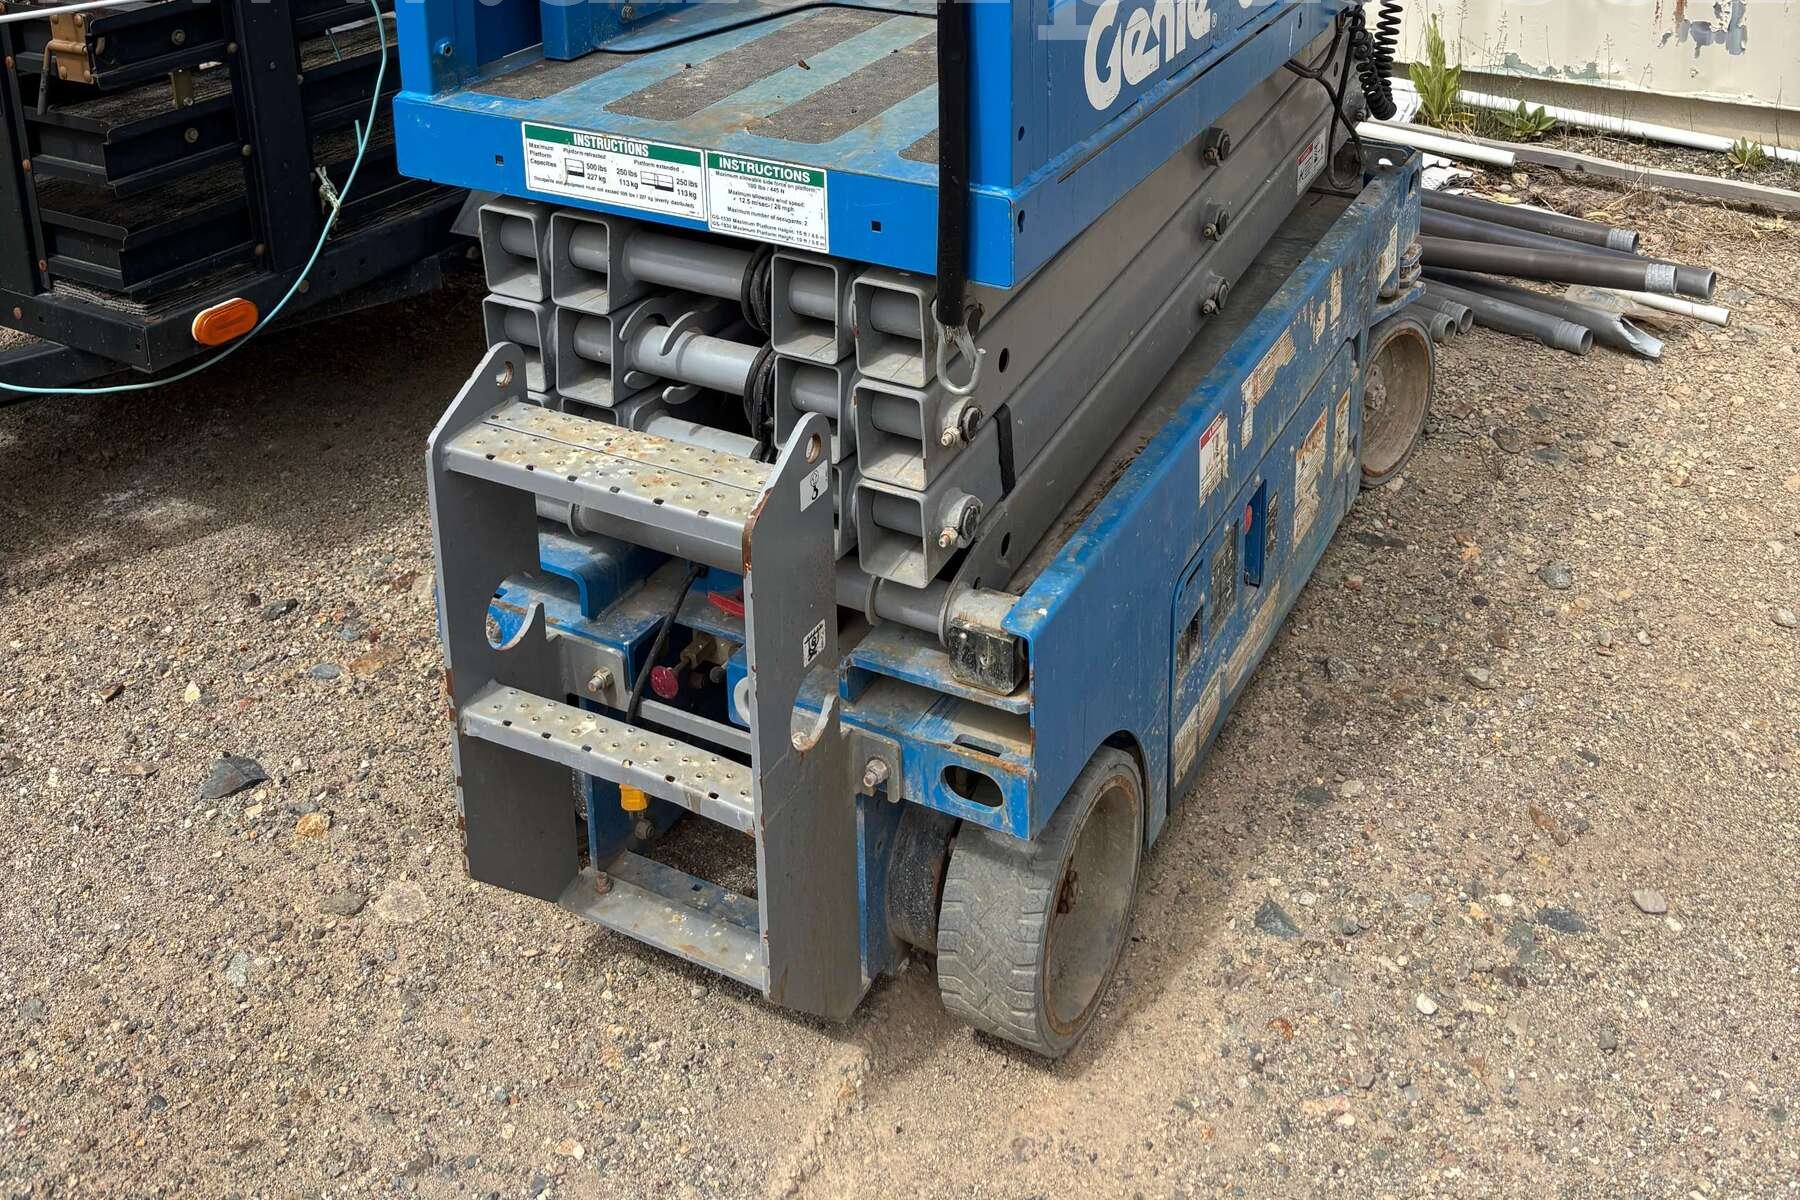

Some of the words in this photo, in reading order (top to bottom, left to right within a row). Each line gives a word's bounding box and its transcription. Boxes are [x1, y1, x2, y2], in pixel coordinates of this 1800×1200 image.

[573, 132, 649, 158] INSTRUCTIONS
[586, 163, 597, 171] 500
[598, 164, 608, 173] lbs
[616, 168, 627, 176] 250
[628, 169, 638, 178] lbs
[719, 157, 811, 183] INSTRUCTIONS
[587, 173, 598, 181] 227
[598, 175, 607, 184] kg
[619, 178, 630, 187] 113
[630, 180, 639, 189] kg
[676, 178, 688, 187] 250
[688, 180, 699, 188] lbs
[677, 189, 688, 197] 113
[689, 191, 697, 200] kg
